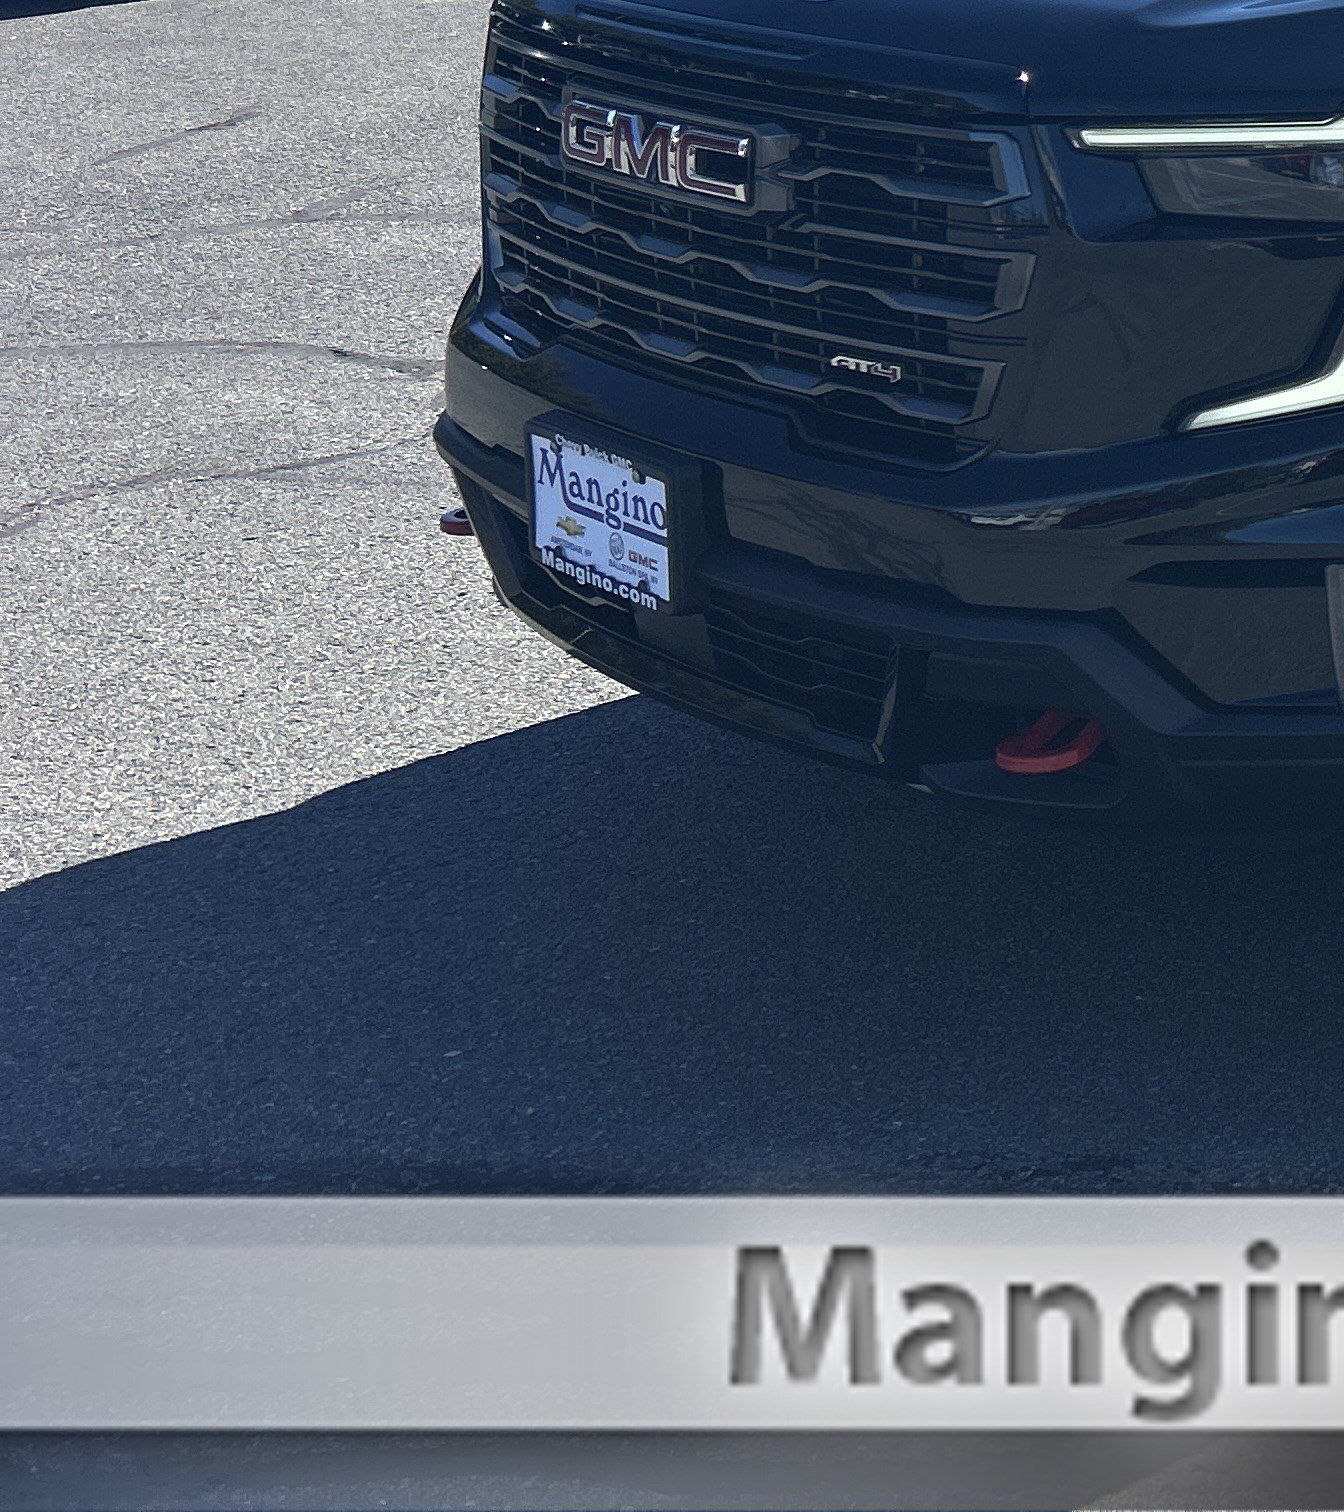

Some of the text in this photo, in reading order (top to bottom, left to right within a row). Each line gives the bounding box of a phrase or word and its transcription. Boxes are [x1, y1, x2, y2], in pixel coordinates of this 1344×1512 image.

[562, 99, 751, 203] GMC
[830, 354, 902, 384] AT4
[538, 447, 668, 535] Mangino
[541, 547, 658, 611] Mangino.com
[628, 549, 659, 572] GMC
